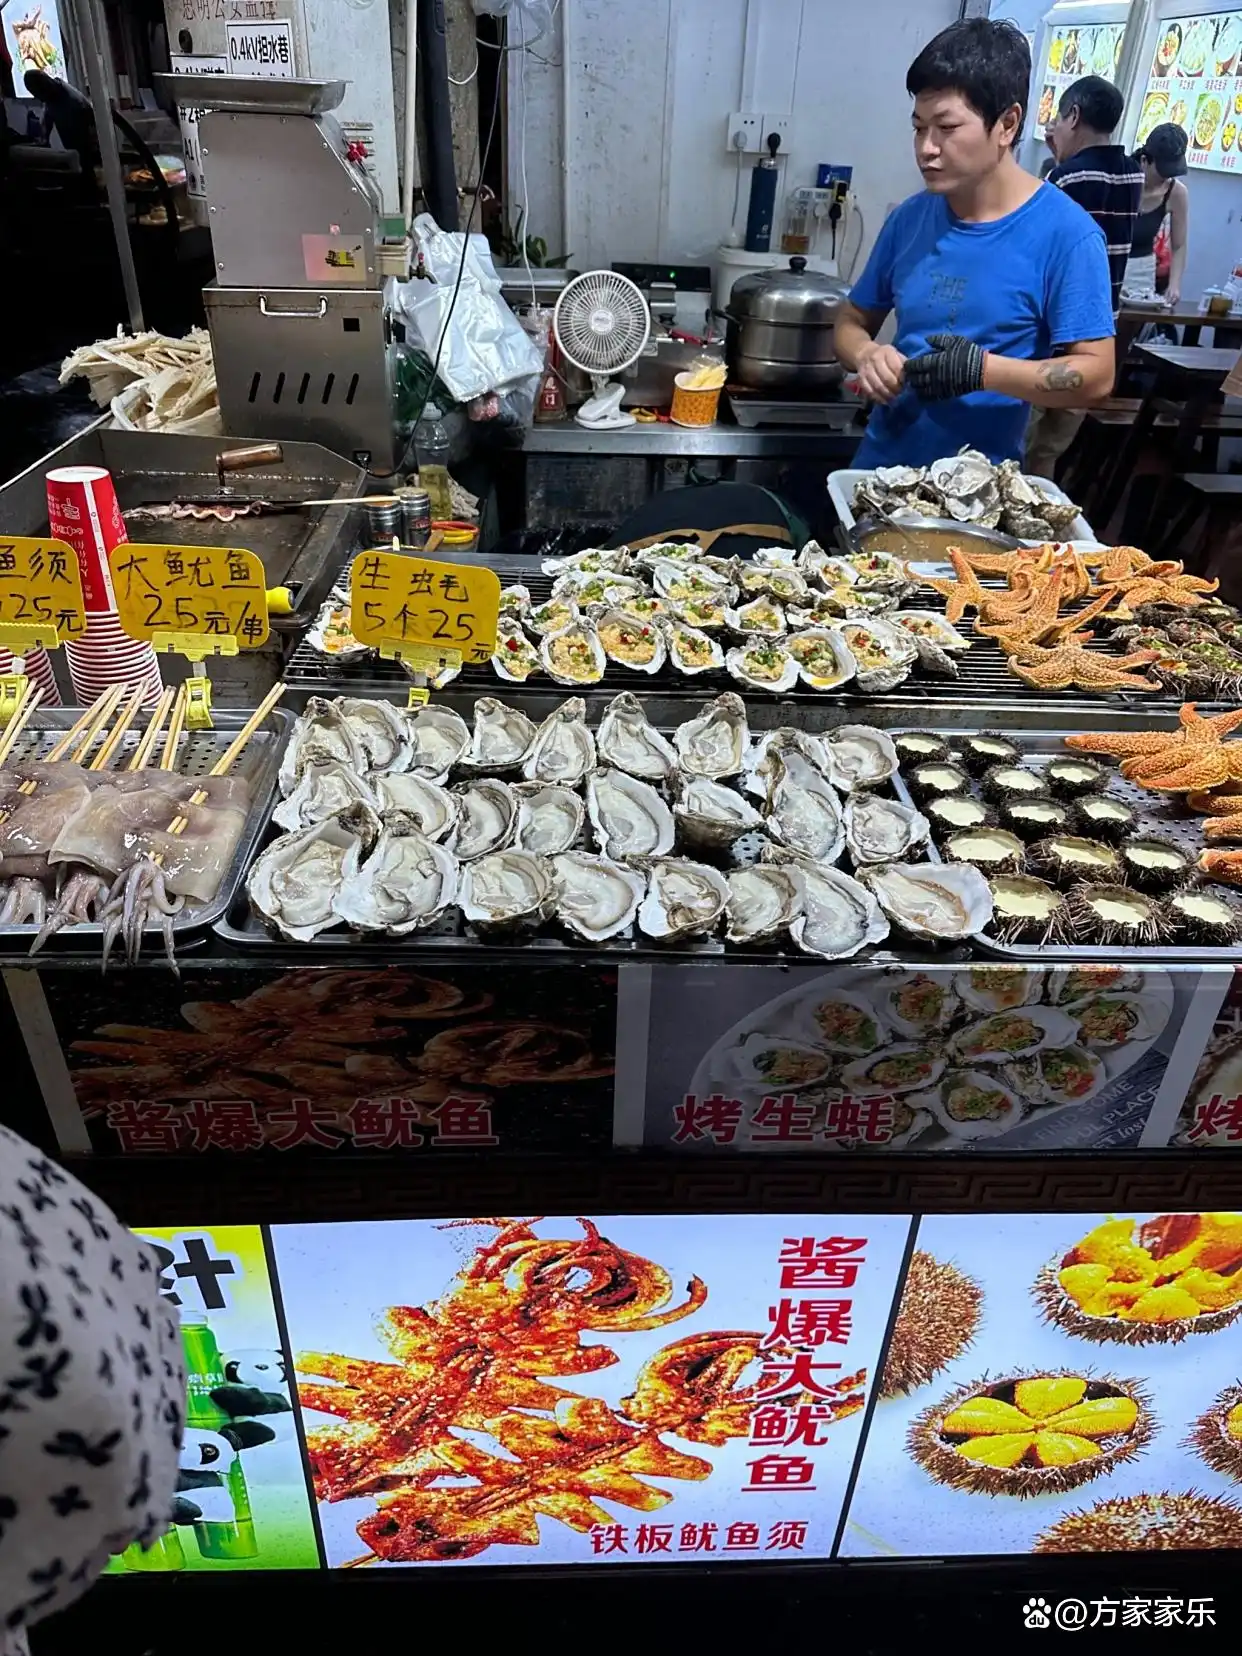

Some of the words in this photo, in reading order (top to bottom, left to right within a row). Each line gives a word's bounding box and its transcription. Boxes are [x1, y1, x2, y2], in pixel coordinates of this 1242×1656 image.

[117, 550, 260, 600] 大鱿鱼
[671, 1094, 896, 1143] 烤生蚝
[1078, 1079, 1134, 1115] SOME
[107, 1097, 498, 1152] 酱爆大鱿鱼
[741, 1236, 868, 1492] 酱爆大鱿鱼
[590, 1520, 809, 1555] 铁板鱿鱼须
